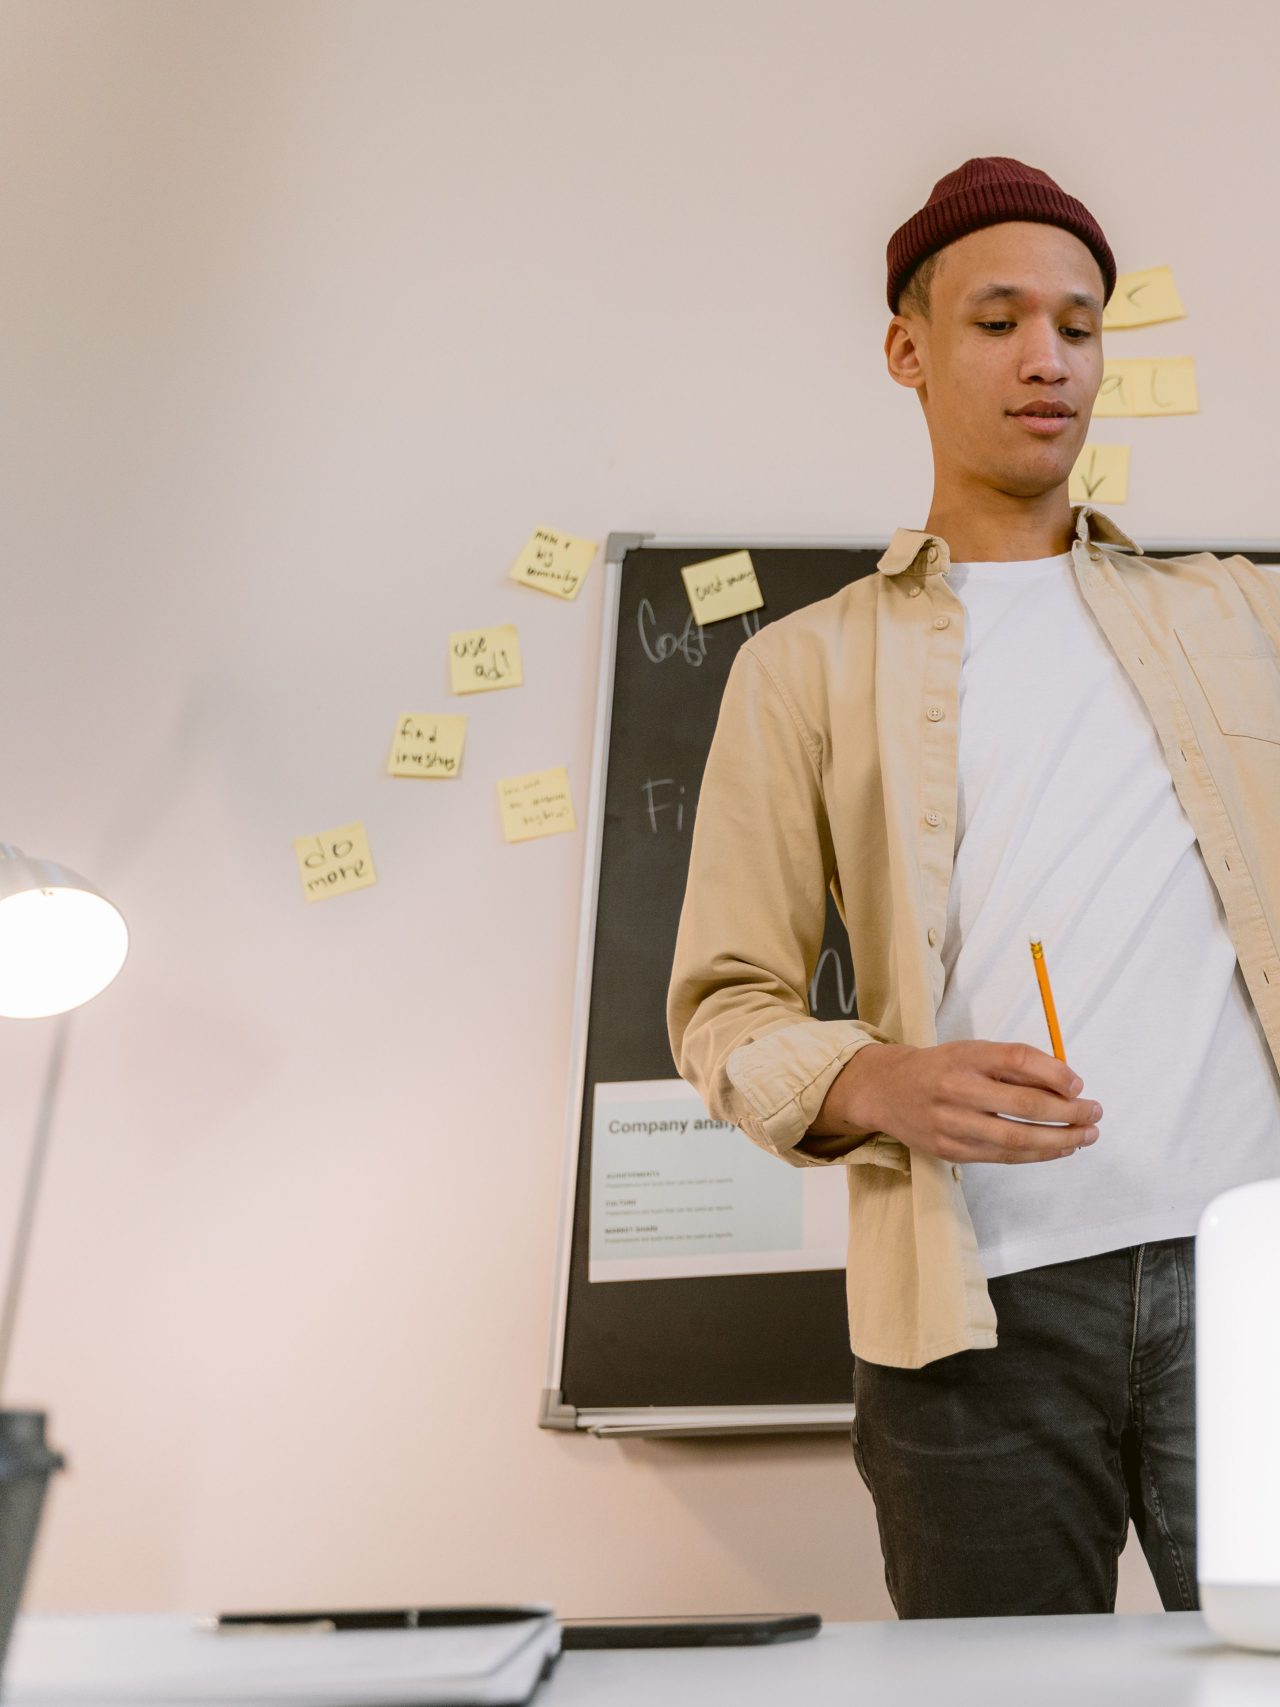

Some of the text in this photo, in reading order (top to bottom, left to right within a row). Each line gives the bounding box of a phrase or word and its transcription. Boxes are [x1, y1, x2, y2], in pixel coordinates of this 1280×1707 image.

[304, 836, 353, 869] do
[307, 859, 368, 892] more
[608, 1116, 743, 1136] Company analy
